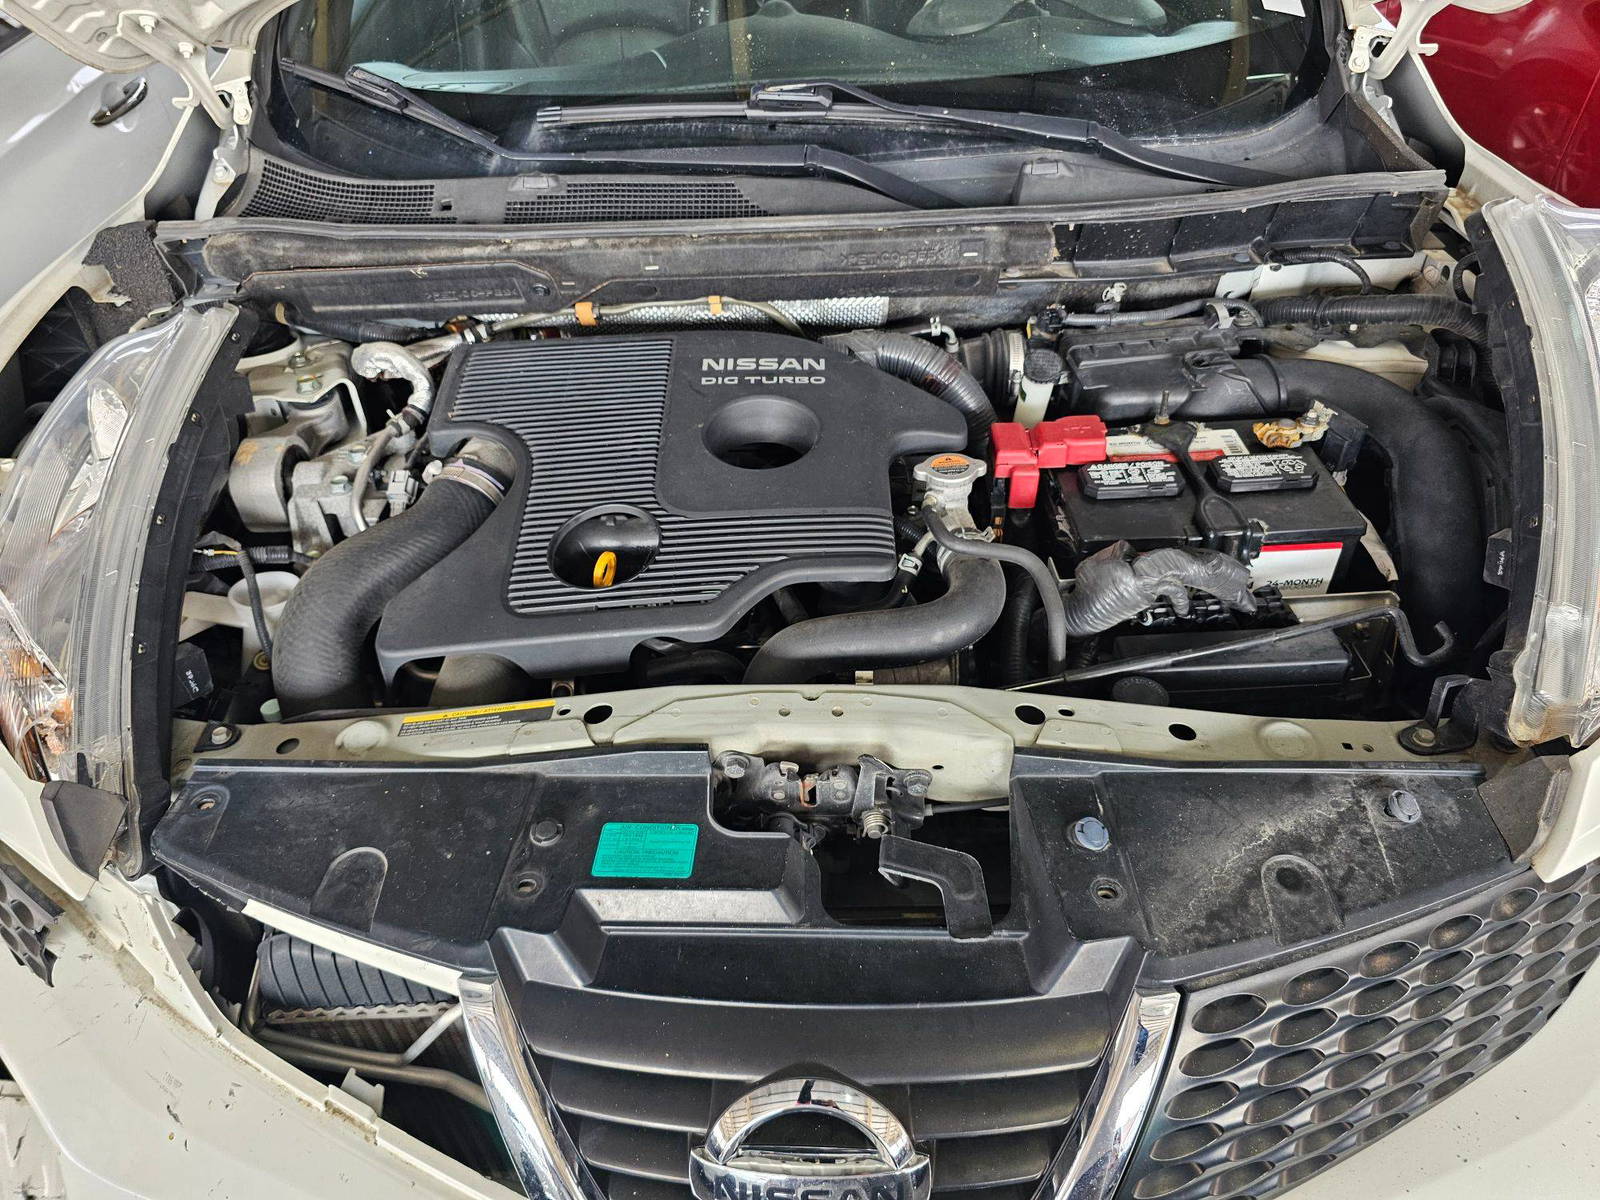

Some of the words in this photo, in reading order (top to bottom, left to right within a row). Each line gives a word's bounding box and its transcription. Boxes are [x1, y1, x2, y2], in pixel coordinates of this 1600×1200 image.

[702, 358, 825, 371] NISSAN
[701, 376, 738, 385] DIG
[744, 376, 826, 384] TURBO
